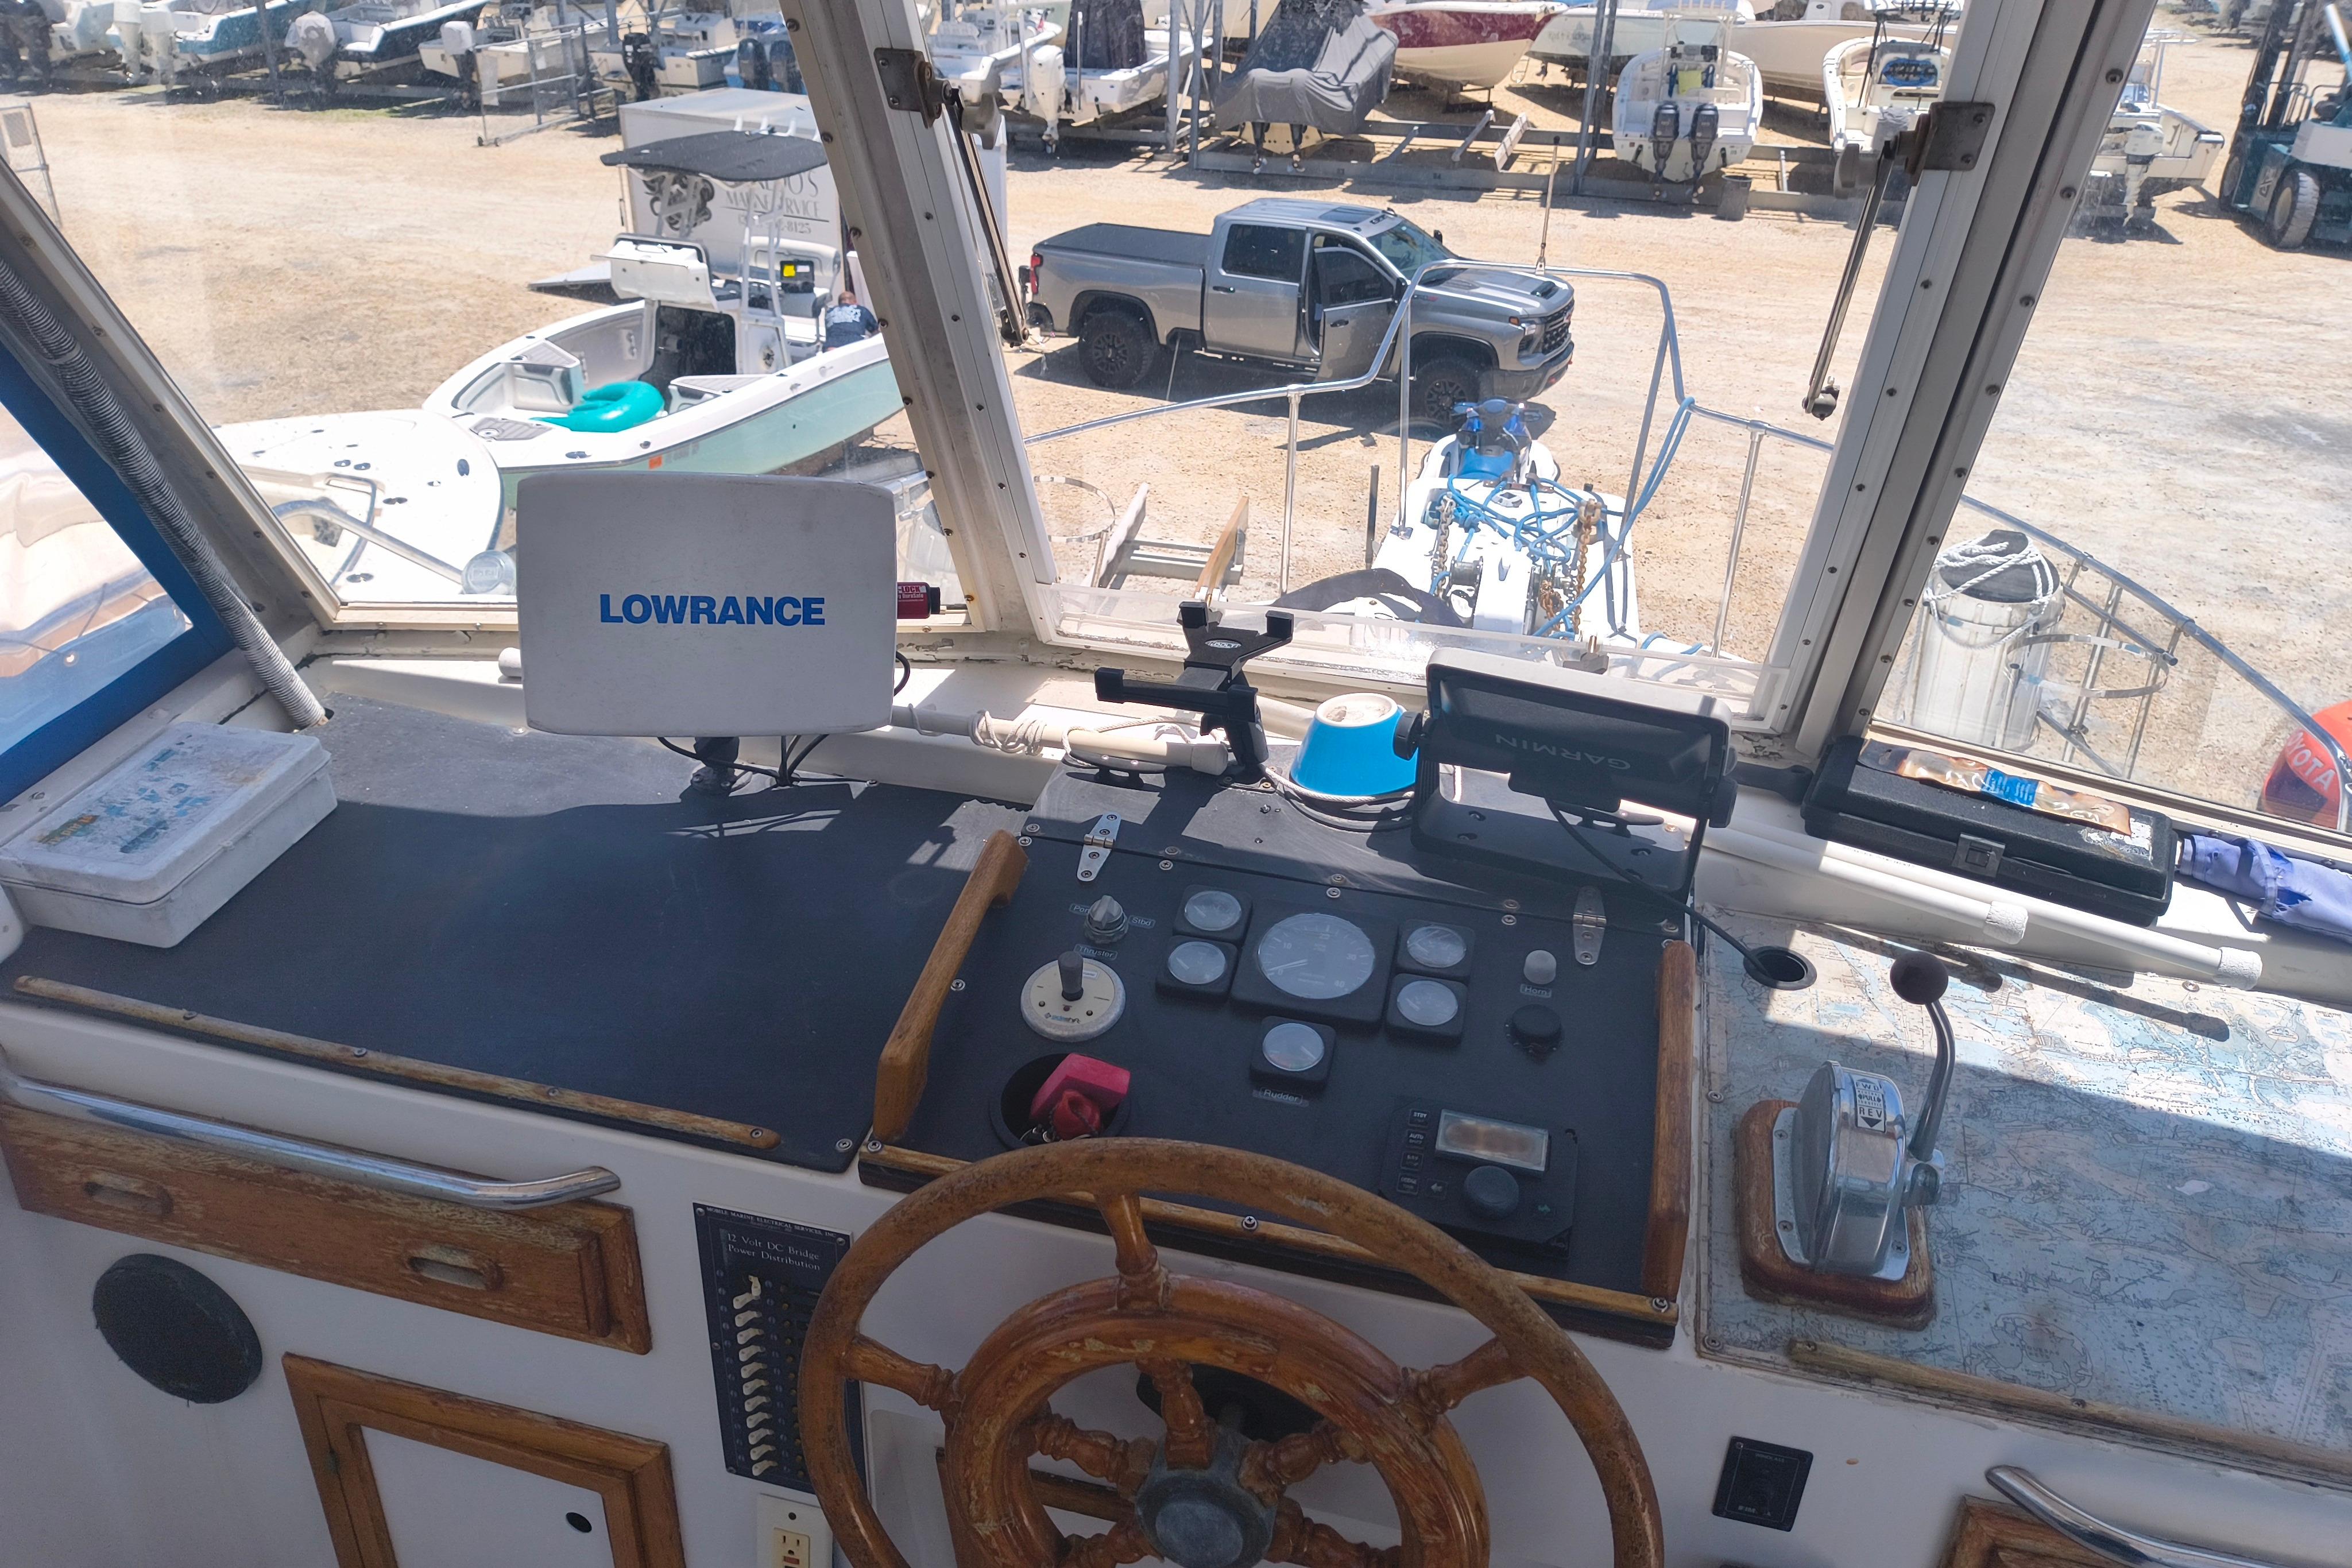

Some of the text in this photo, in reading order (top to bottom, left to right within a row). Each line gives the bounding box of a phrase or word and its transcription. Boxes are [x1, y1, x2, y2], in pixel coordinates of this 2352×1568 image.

[600, 594, 825, 626] LOWRANCE
[1496, 734, 1631, 770] GARMIN
[2287, 731, 2336, 791] OYOTA
[1074, 905, 1090, 914] Por
[1132, 917, 1152, 927] Stbd
[1080, 946, 1114, 958] Thruster
[1334, 980, 1346, 988] 40
[1525, 986, 1548, 996] Horn
[1264, 1089, 1299, 1102] Rudder
[1862, 1094, 1877, 1102] PULL
[1859, 1106, 1882, 1118] REV
[2224, 1114, 2269, 1126] SOUND
[706, 1206, 729, 1215] MOBILE
[730, 1211, 754, 1221] MARINE
[756, 1217, 792, 1229] ELECTRICAL
[728, 1233, 819, 1261] 12 Volt DC Bridge
[728, 1244, 821, 1271] Power Distribution
